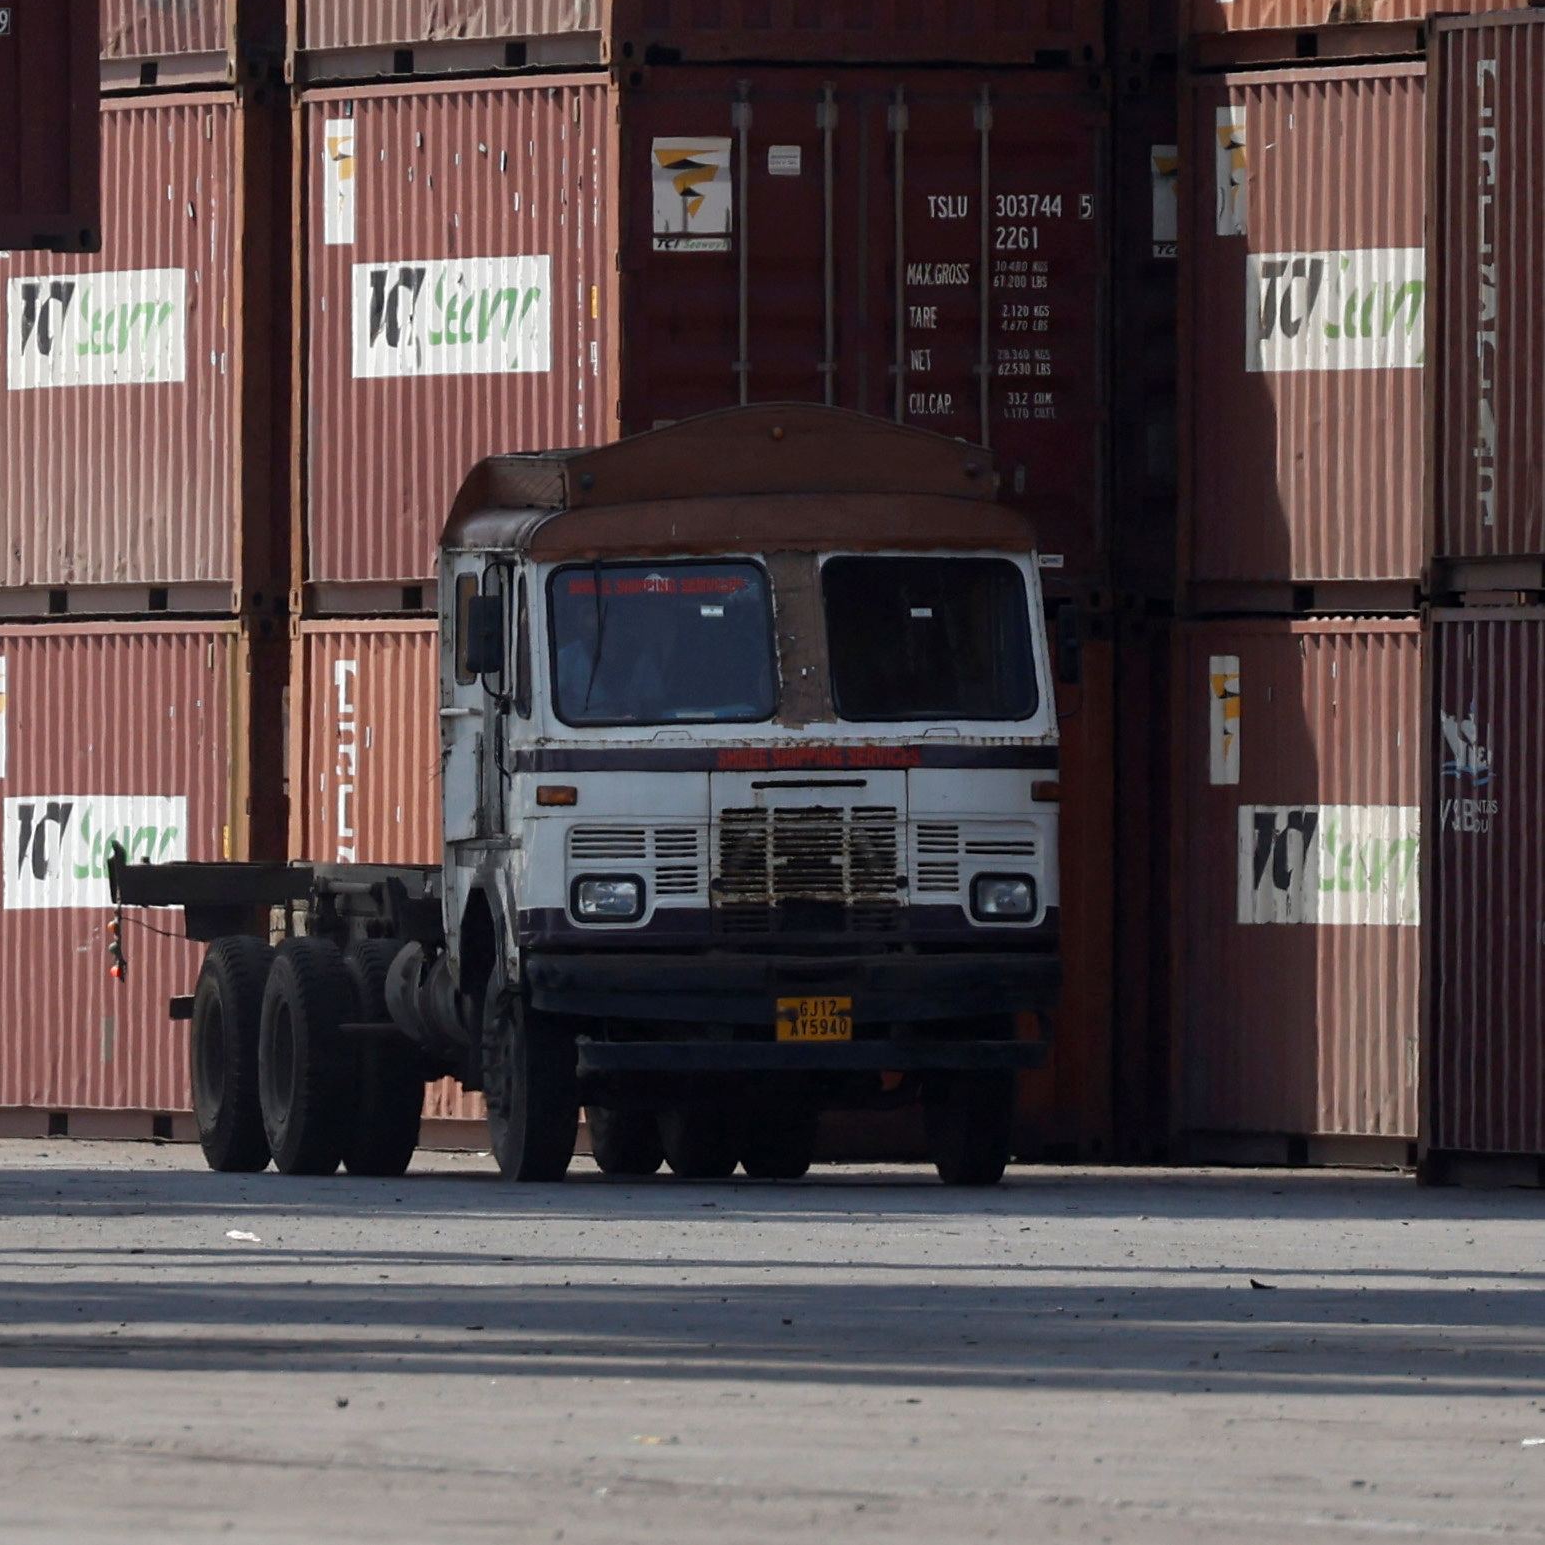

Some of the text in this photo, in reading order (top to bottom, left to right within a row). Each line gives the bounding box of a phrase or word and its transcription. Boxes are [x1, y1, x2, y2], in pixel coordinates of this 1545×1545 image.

[928, 194, 1094, 220] TSLU 303744 5
[657, 238, 680, 249] TCI
[995, 227, 1038, 250] 22G1
[906, 263, 971, 286] MAX.GROSS
[1032, 276, 1049, 289] LBS
[909, 305, 1051, 329] TARE 2.120 KGS
[1032, 320, 1049, 332] LBS
[910, 348, 932, 371] NET
[1035, 363, 1052, 375] LBS
[909, 393, 955, 415] CU.CAP.
[773, 747, 843, 767] SHIPPING
[846, 745, 922, 766] SERVICES
[799, 999, 837, 1017] GJ12
[790, 1018, 848, 1037] AY5940
